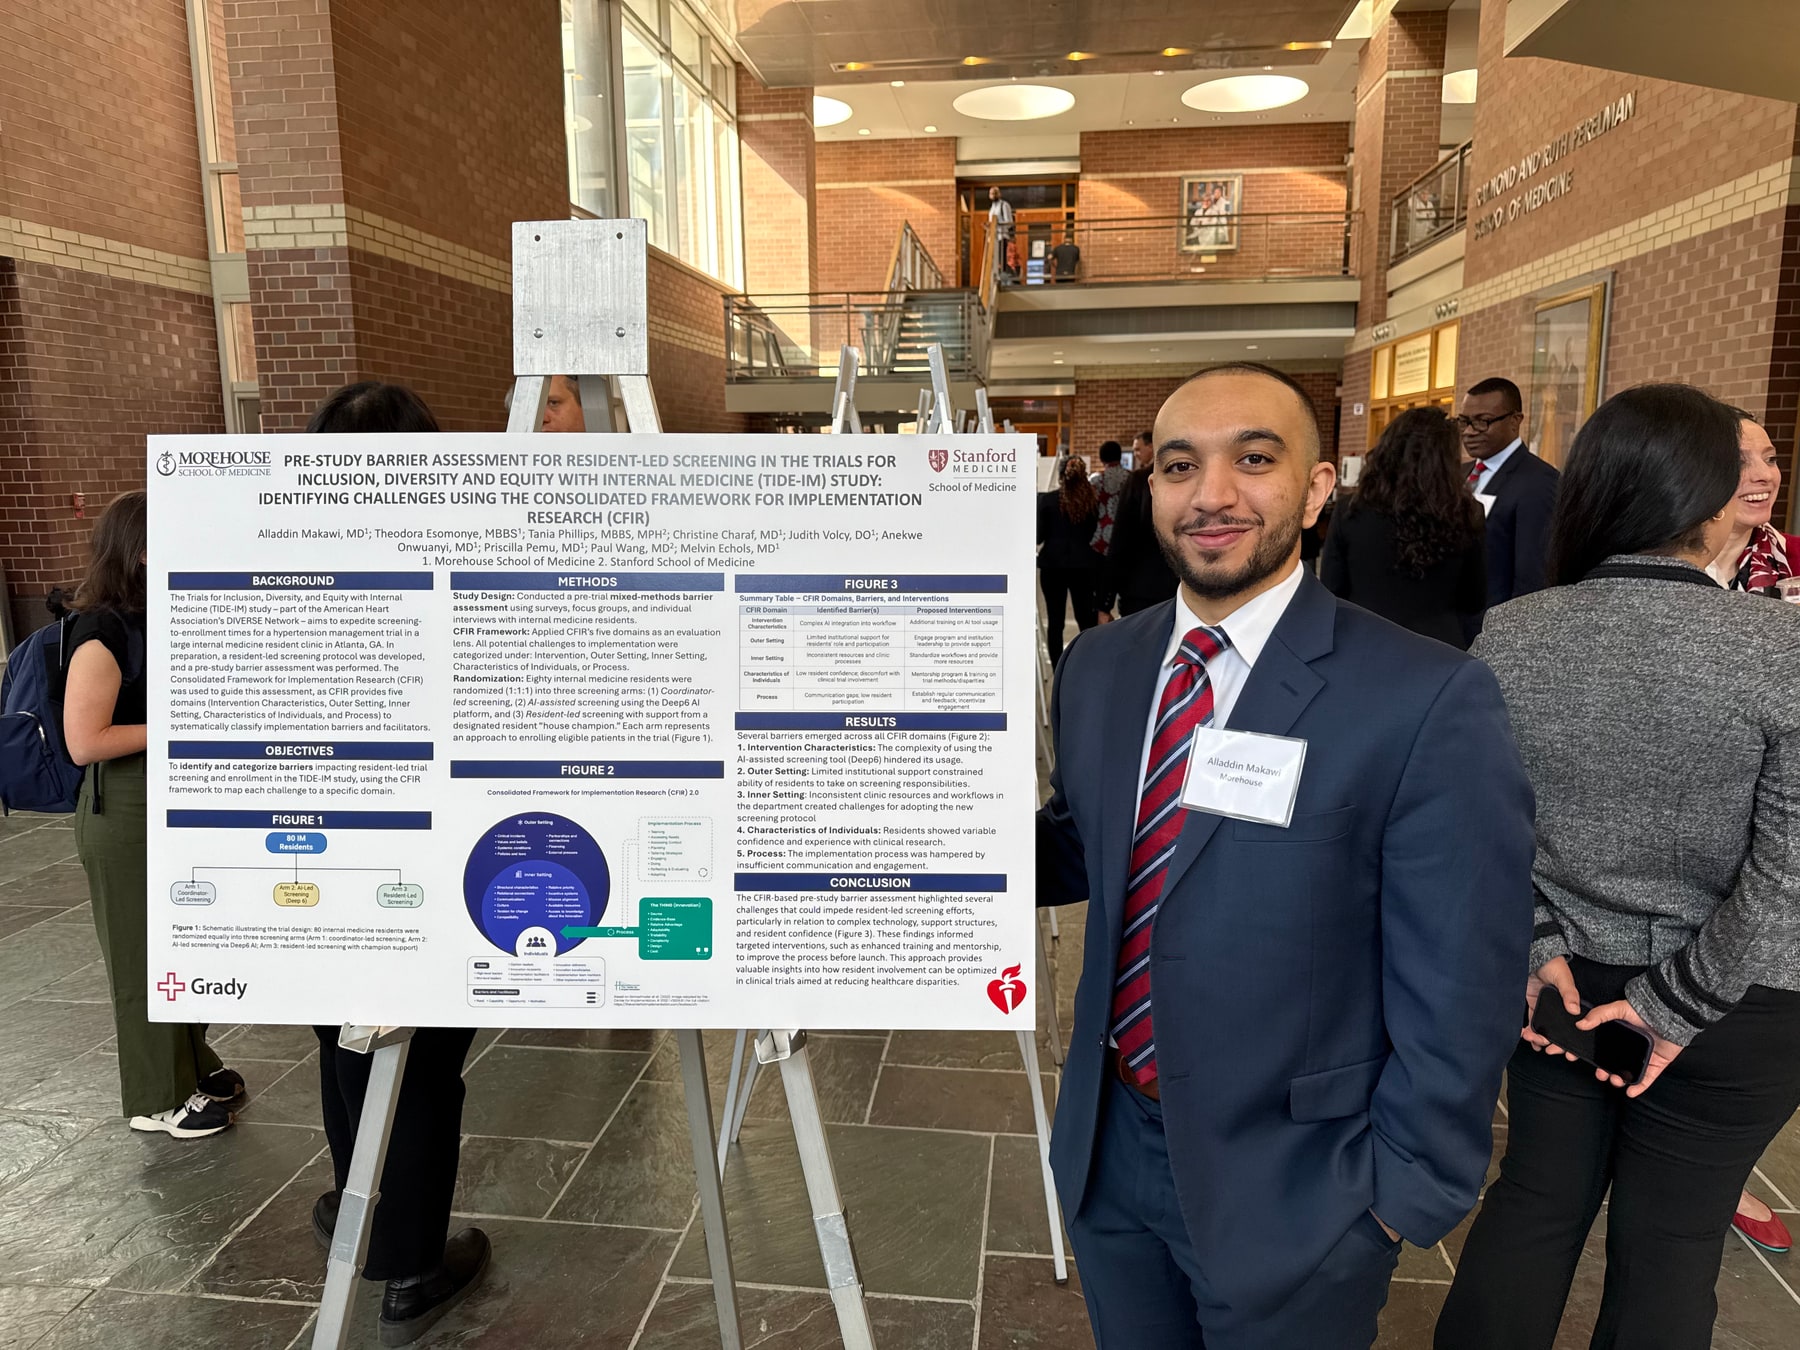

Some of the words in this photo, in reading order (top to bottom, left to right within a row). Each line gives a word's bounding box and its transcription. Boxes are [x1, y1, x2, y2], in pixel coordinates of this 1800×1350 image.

[1518, 151, 1541, 183] AND
[1542, 132, 1571, 167] RUTH
[1508, 196, 1522, 220] OF
[1524, 169, 1574, 215] MEDICINE
[179, 452, 271, 467] MOREHOUSE
[953, 448, 1016, 462] Stanford
[284, 454, 362, 467] PRE-STUDY
[367, 454, 428, 466] BARRIER
[432, 454, 528, 466] ASSESSMENT
[533, 454, 562, 466] FOR
[567, 454, 668, 467] RESIDENT-LED
[673, 455, 756, 467] SCREENING
[762, 456, 776, 467] IN
[781, 455, 808, 467] THE
[813, 455, 862, 467] TRIALS
[868, 455, 896, 468] FOR
[179, 468, 214, 476] SCHOOL
[215, 468, 227, 476] OF
[229, 468, 271, 476] MEDICINE
[953, 465, 1016, 473] MEDICINE
[298, 473, 380, 488] INCLUSION,
[385, 473, 458, 485] DIVERSITY
[462, 473, 495, 485] AND
[500, 473, 554, 487] EQUITY
[558, 473, 598, 485] WITH
[604, 474, 676, 486] INTERNAL
[681, 474, 753, 486] MEDICINE
[758, 474, 826, 489] (TIDE-IM)
[831, 474, 881, 486] STUDY:
[929, 482, 961, 494] School
[962, 482, 972, 492] of
[974, 482, 1016, 492] Medicine
[259, 492, 349, 505] IDENTIFYING
[354, 492, 446, 504] CHALLENGES
[451, 492, 496, 504] USING
[501, 492, 529, 504] THE
[534, 492, 646, 505] CONSOLIDATED
[652, 493, 750, 505] FRAMEWORK
[756, 494, 784, 506] FOR
[789, 493, 921, 506] IMPLEMENTATION
[528, 511, 602, 524] RESEARCH
[608, 510, 649, 527] (CFIR)
[257, 529, 298, 541] Alladdin
[302, 528, 343, 540] Makawi,
[374, 527, 423, 541] Theodora
[427, 528, 482, 540] Esomonye,
[528, 529, 555, 538] Tania
[559, 529, 597, 541] Phillips,
[601, 529, 634, 541] MBBS,
[673, 529, 718, 539] Christine
[722, 530, 756, 541] Charaf,
[788, 530, 819, 541] Judith
[822, 530, 852, 542] Volcy,
[882, 530, 922, 541] Anekwe
[423, 556, 431, 565] 1.
[435, 556, 494, 567] Morehouse
[496, 556, 530, 567] School
[534, 556, 544, 566] of
[548, 556, 595, 566] Medicine
[598, 557, 607, 566] 2.
[610, 556, 654, 567] Stanford
[657, 557, 690, 567] School
[694, 557, 705, 566] of
[708, 557, 755, 567] Medicine
[253, 576, 334, 586] BACKGROUND
[558, 577, 617, 586] METHODS
[845, 580, 888, 589] FIGURE
[891, 580, 898, 589] 3
[224, 594, 264, 602] Inclusion,
[266, 594, 303, 603] Diversity,
[305, 593, 320, 601] and
[323, 593, 349, 603] Equity
[453, 592, 479, 601] Study
[481, 592, 515, 601] Design:
[574, 593, 608, 601] pre-trial
[740, 595, 774, 603] Summary
[846, 717, 896, 726] RESULTS
[805, 732, 842, 741] emerged
[887, 732, 908, 740] CFIR
[948, 732, 977, 741] (Figure
[979, 733, 990, 741] 2):
[266, 746, 334, 756] OBJECTIVES
[180, 762, 212, 771] identify
[232, 763, 277, 771] categorize
[316, 764, 357, 772] impacting
[562, 765, 604, 775] FIGURE
[608, 766, 614, 775] 2
[1208, 758, 1243, 771] Alladdin
[1246, 764, 1282, 776] Makawi
[1220, 773, 1263, 787] Morehouse
[581, 789, 634, 797] Implementation
[668, 788, 688, 797] (CFIR)
[273, 815, 314, 824] FIGURE
[318, 816, 322, 824] 1
[830, 878, 910, 888] CONCLUSION
[800, 894, 838, 903] pre-study
[841, 894, 868, 902] barrier
[918, 894, 962, 903] highlighted
[191, 978, 247, 1000] Grady
